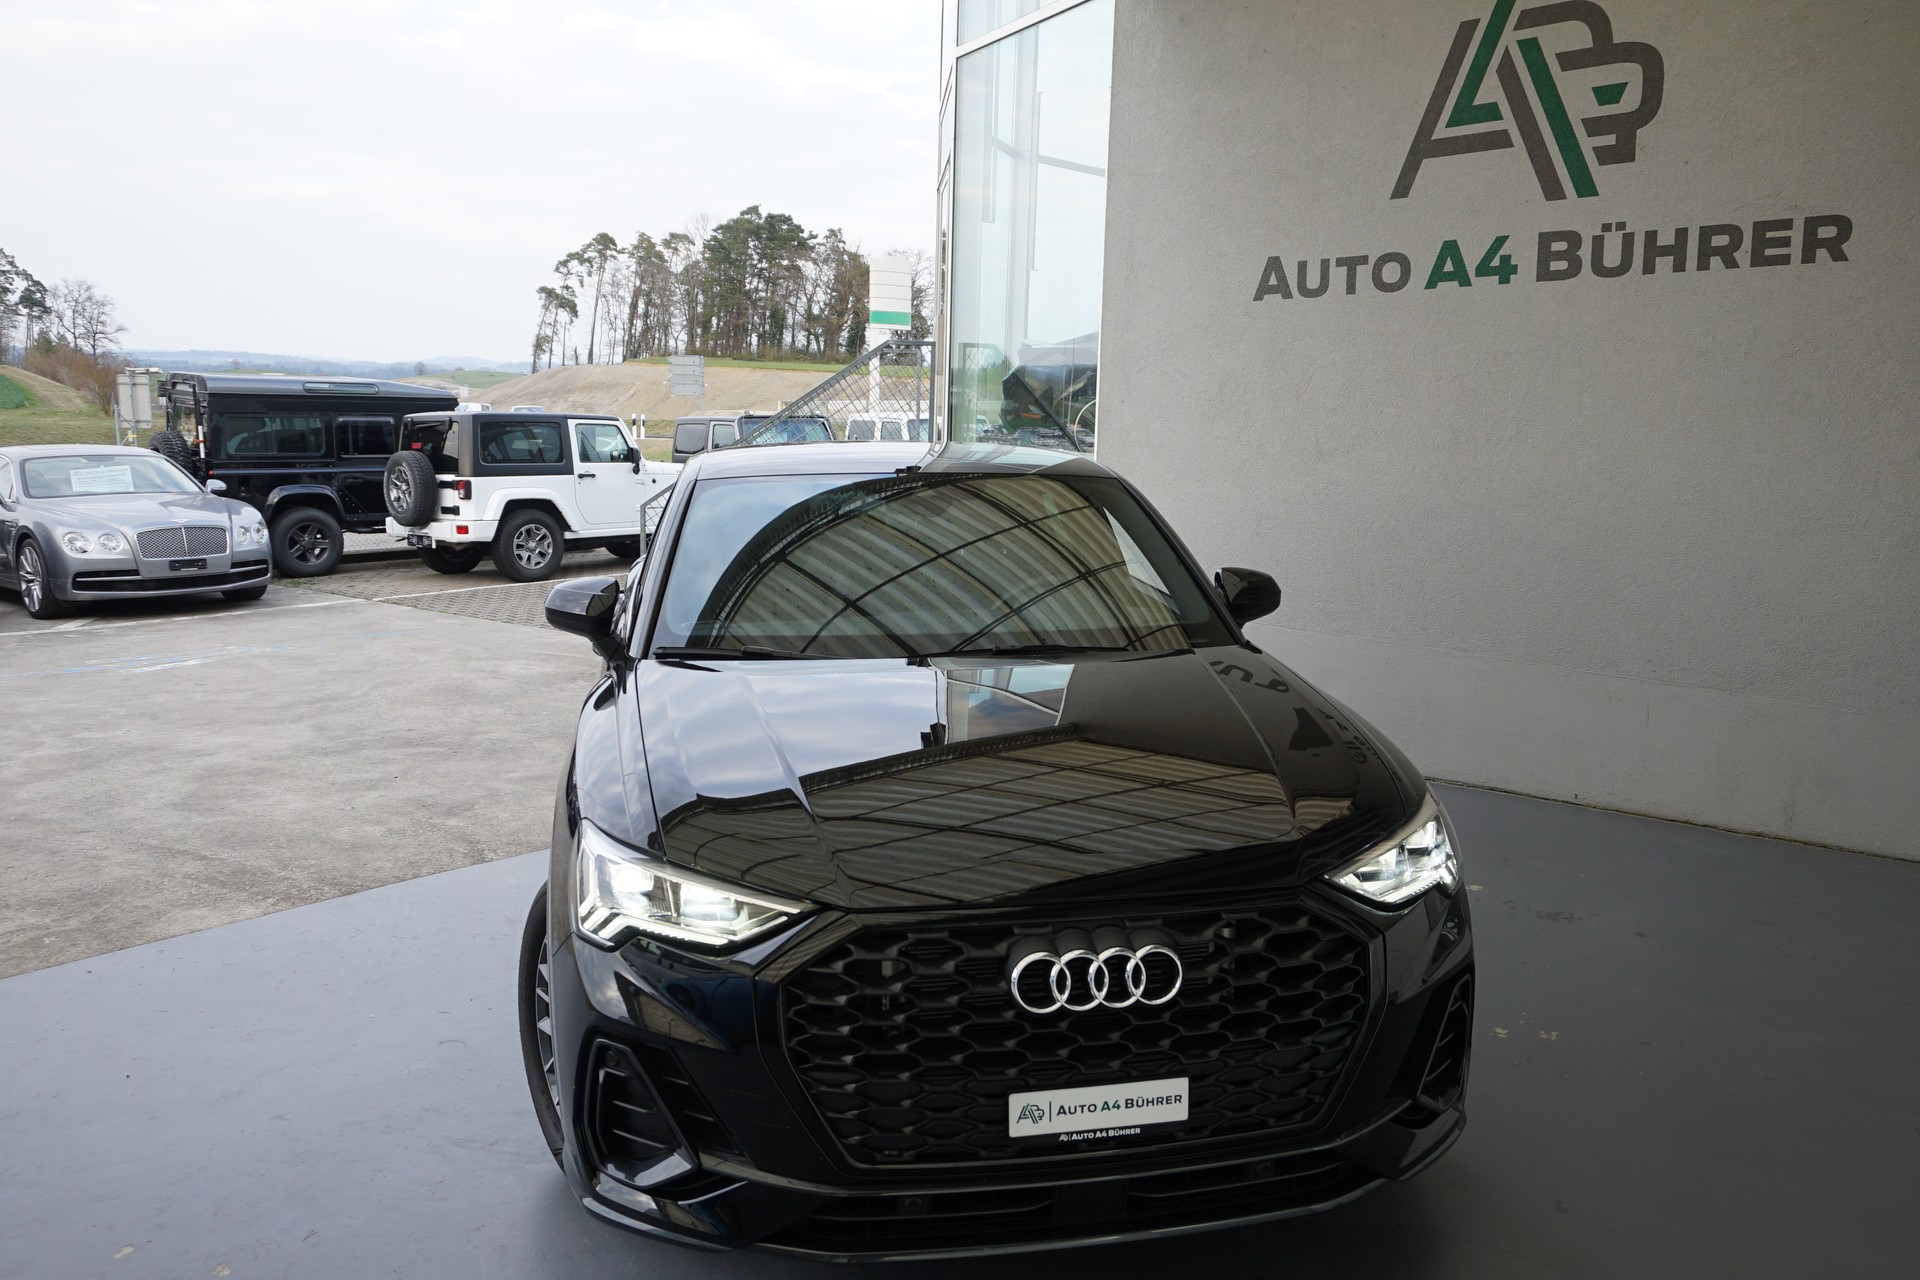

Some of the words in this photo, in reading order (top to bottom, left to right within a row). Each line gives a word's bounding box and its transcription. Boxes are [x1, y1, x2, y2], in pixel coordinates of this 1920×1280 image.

[1253, 252, 1412, 302] AUTO
[1424, 235, 1518, 290] A4
[1535, 214, 1853, 283] BÜHRER
[1056, 1103, 1097, 1117] AUTO
[1100, 1099, 1121, 1112] A4
[1124, 1094, 1183, 1110] BÜHRER
[1071, 1132, 1094, 1141] AUTO
[1095, 1130, 1107, 1139] A4
[1108, 1127, 1141, 1137] BÜHRER
